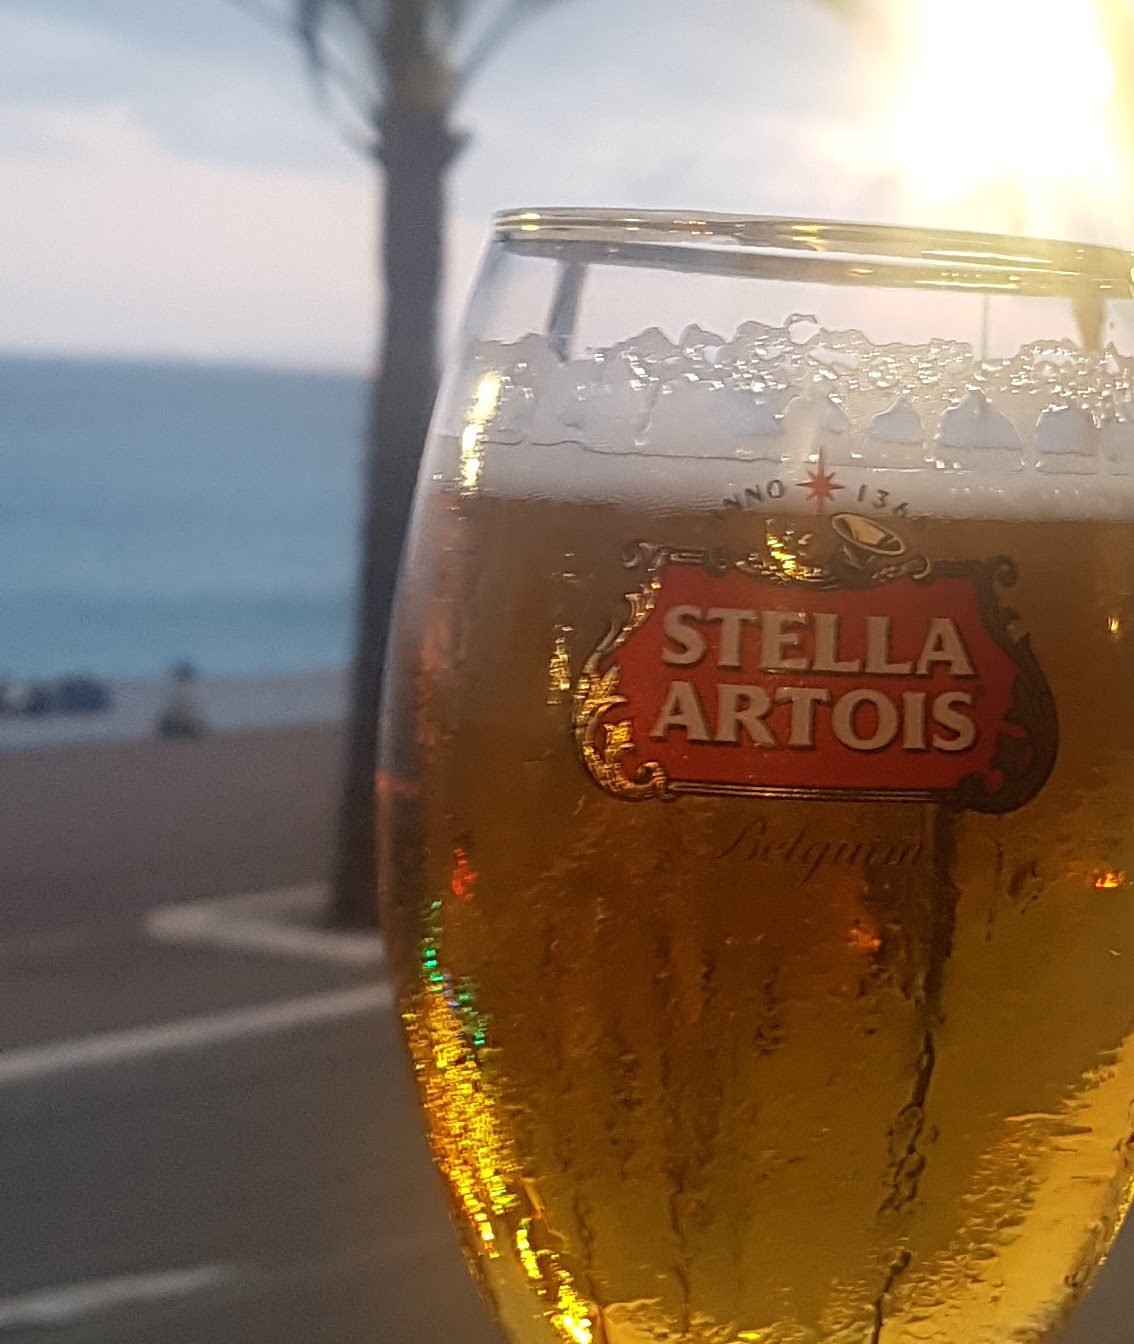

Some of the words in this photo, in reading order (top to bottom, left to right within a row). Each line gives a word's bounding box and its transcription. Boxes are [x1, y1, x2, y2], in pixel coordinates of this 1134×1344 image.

[714, 478, 786, 514] NNO
[660, 604, 977, 677] STELLA
[650, 680, 979, 753] ARTOIS
